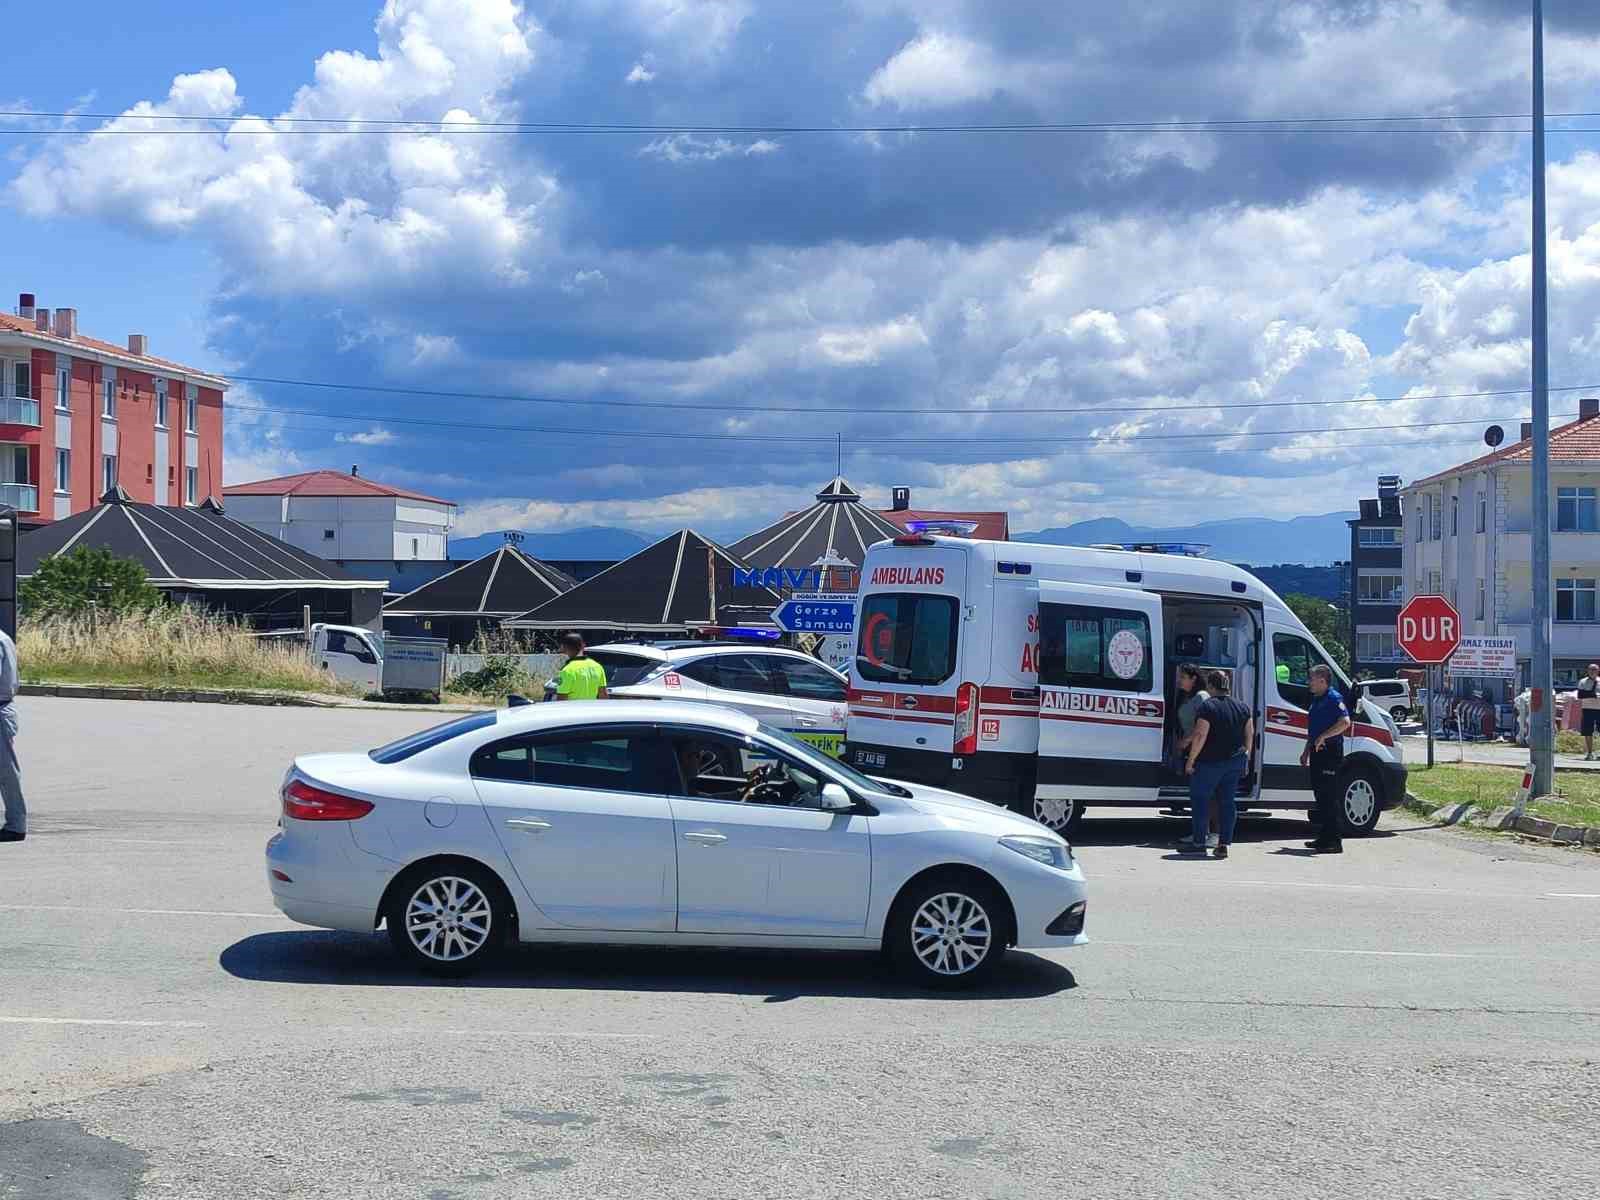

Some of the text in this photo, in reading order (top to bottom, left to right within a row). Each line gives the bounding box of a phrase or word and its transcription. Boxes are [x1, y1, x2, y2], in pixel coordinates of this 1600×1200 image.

[870, 567, 945, 585] AMBULANS
[795, 605, 838, 616] Gerze
[795, 618, 852, 630] Samsun
[1403, 617, 1454, 641] DUR
[1043, 691, 1139, 715] AMBULANS
[984, 721, 998, 732] 112
